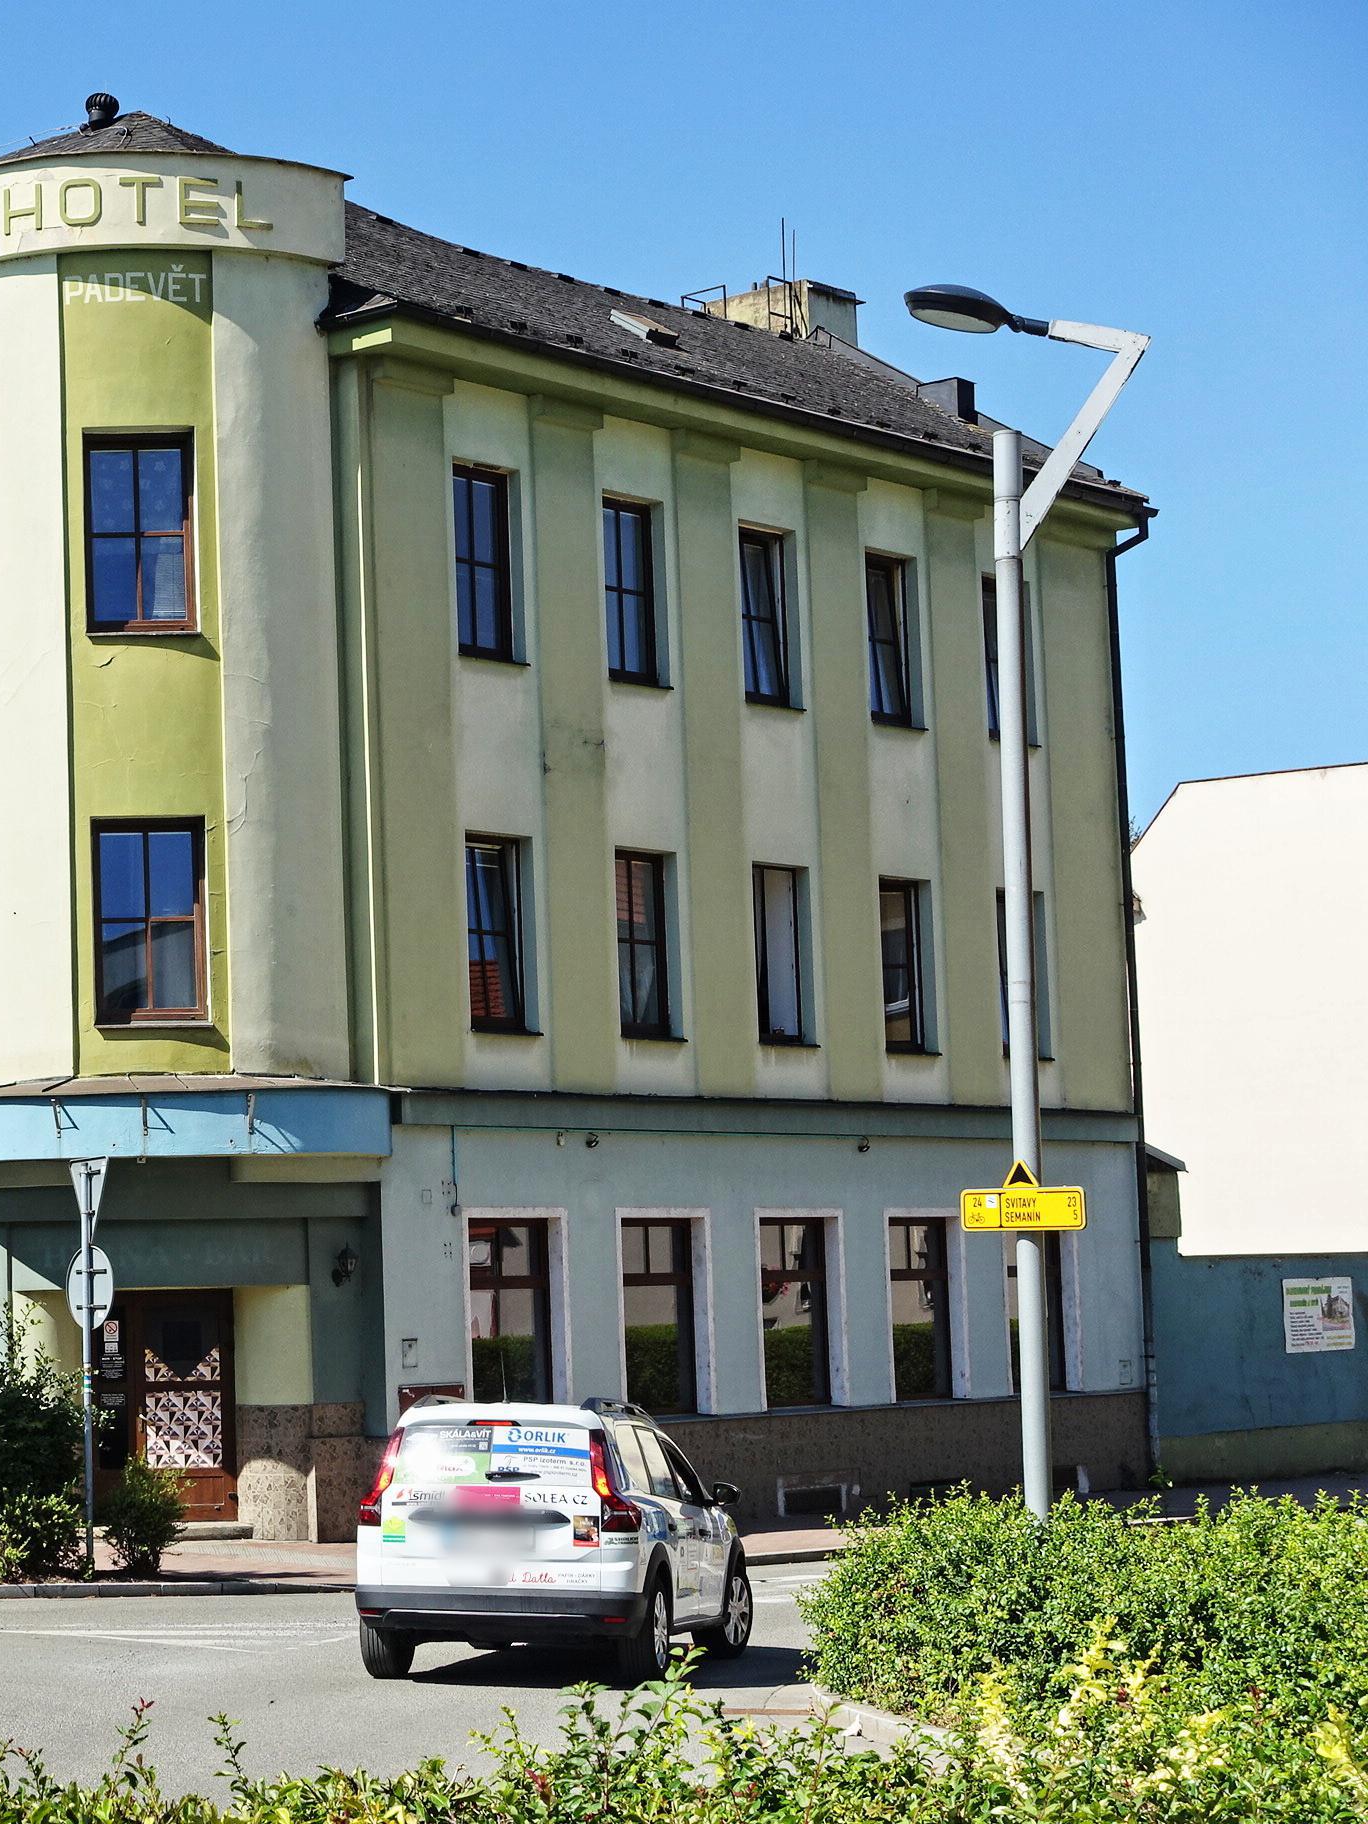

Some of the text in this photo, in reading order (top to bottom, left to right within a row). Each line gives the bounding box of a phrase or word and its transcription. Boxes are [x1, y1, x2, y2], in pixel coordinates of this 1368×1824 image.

[3, 176, 273, 235] HOTEL
[63, 264, 206, 305] PADEVĚT
[973, 1197, 982, 1208] 24
[1005, 1196, 1077, 1208] SVITAVY 23
[1073, 1210, 1078, 1220] 5
[524, 1430, 567, 1444] ORLIK
[518, 1446, 557, 1454] www.orlik.cz
[524, 1492, 568, 1505] SOLEA
[572, 1494, 589, 1505] CZ
